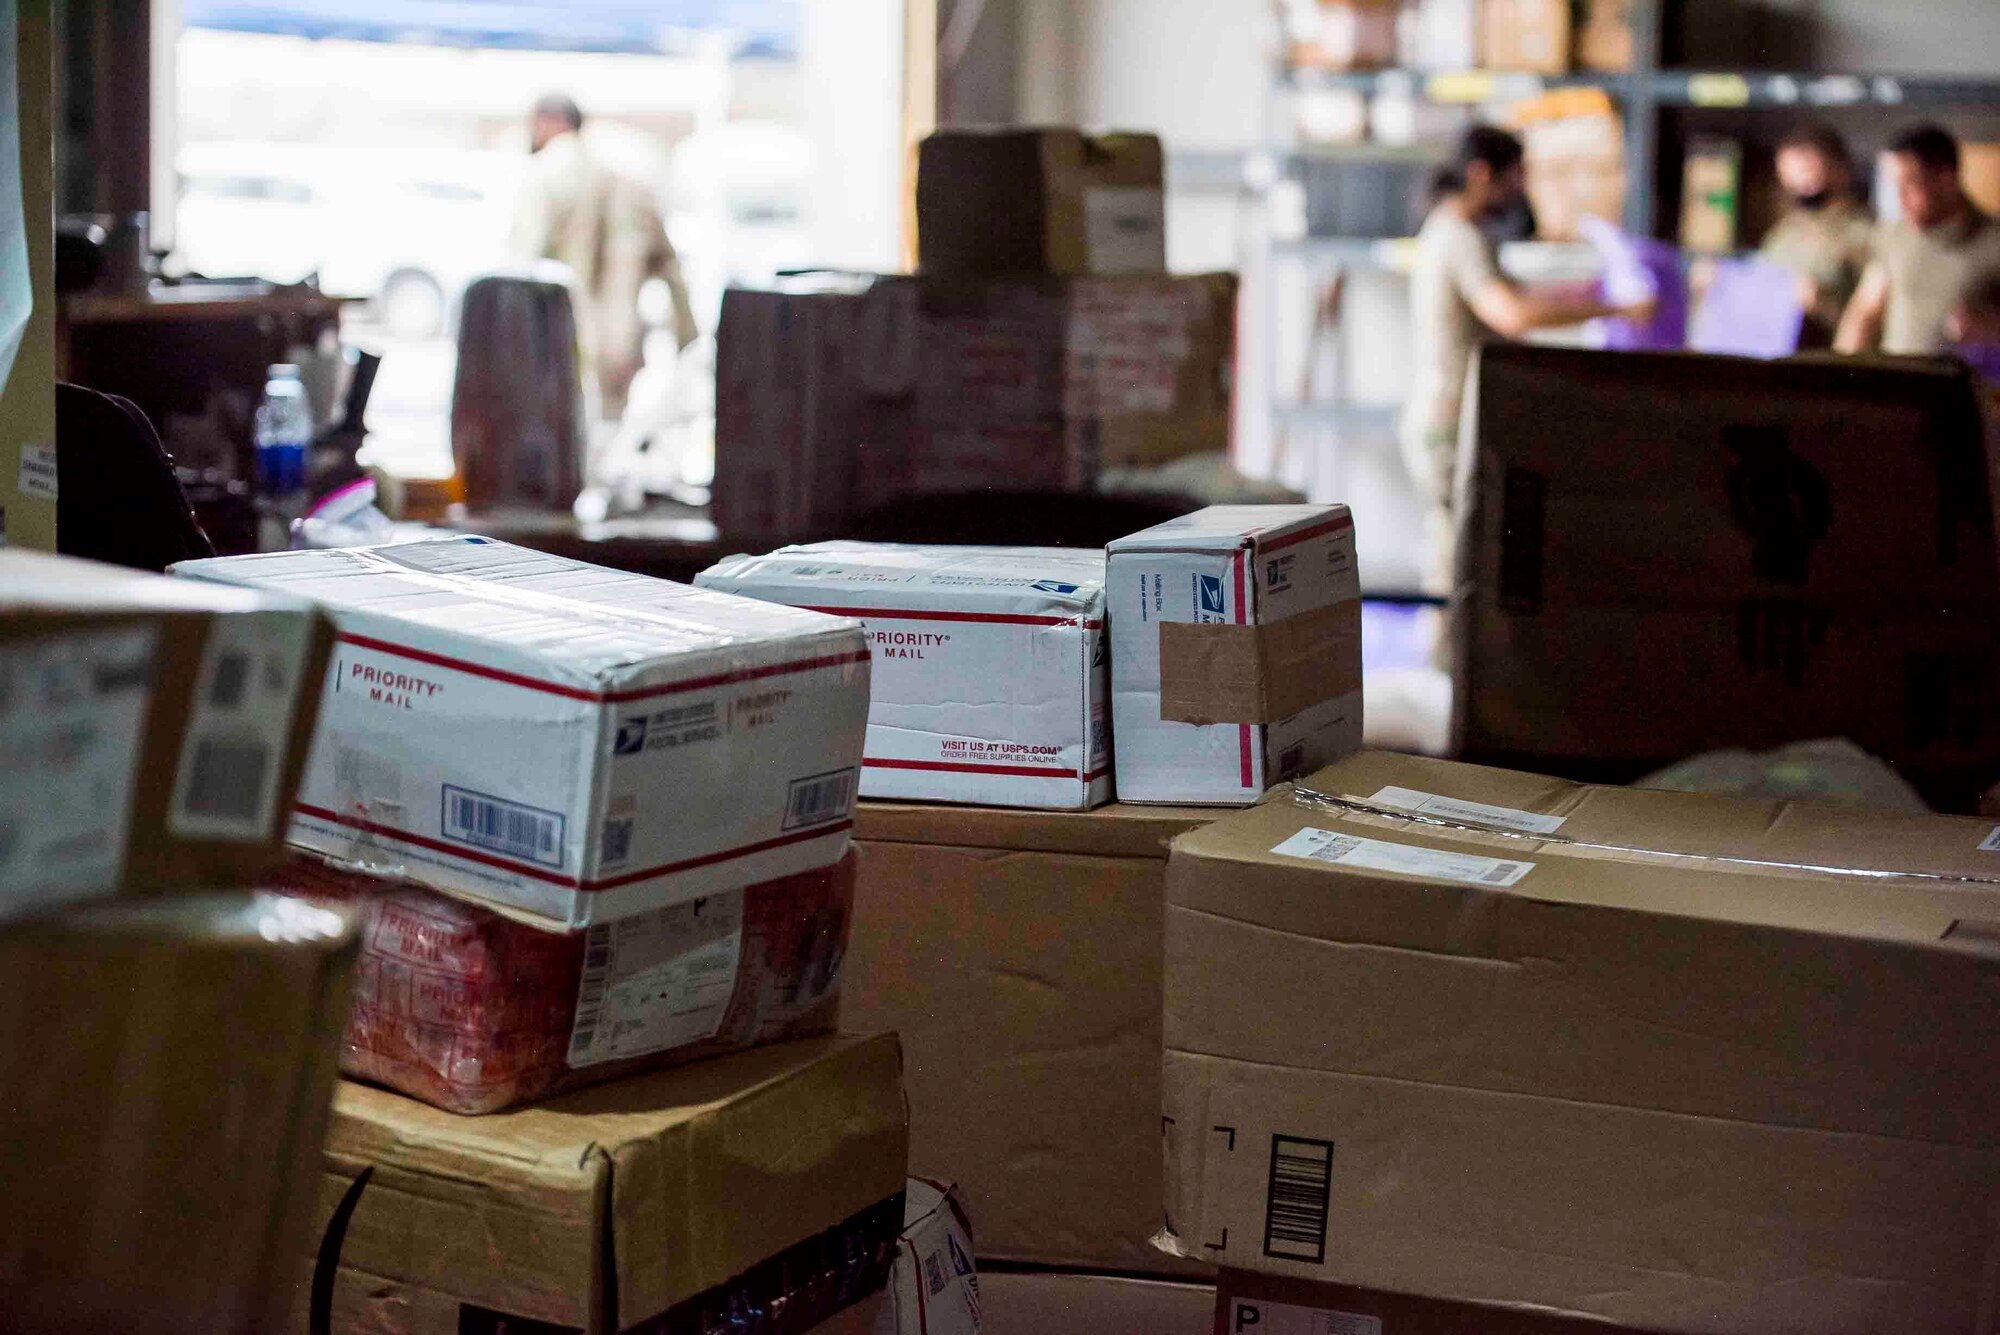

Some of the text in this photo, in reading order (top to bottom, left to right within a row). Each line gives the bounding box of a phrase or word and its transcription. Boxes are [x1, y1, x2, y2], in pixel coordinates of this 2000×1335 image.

[1155, 598, 1163, 612] Box
[884, 647, 925, 660] MAIL
[370, 687, 412, 709] MAIL
[941, 740, 967, 751] VISIT
[969, 742, 984, 751] US
[986, 743, 998, 752] AT
[940, 750, 1057, 763] ORDER FREE SUPPLIES ONLINE
[1235, 1303, 1260, 1333] P
